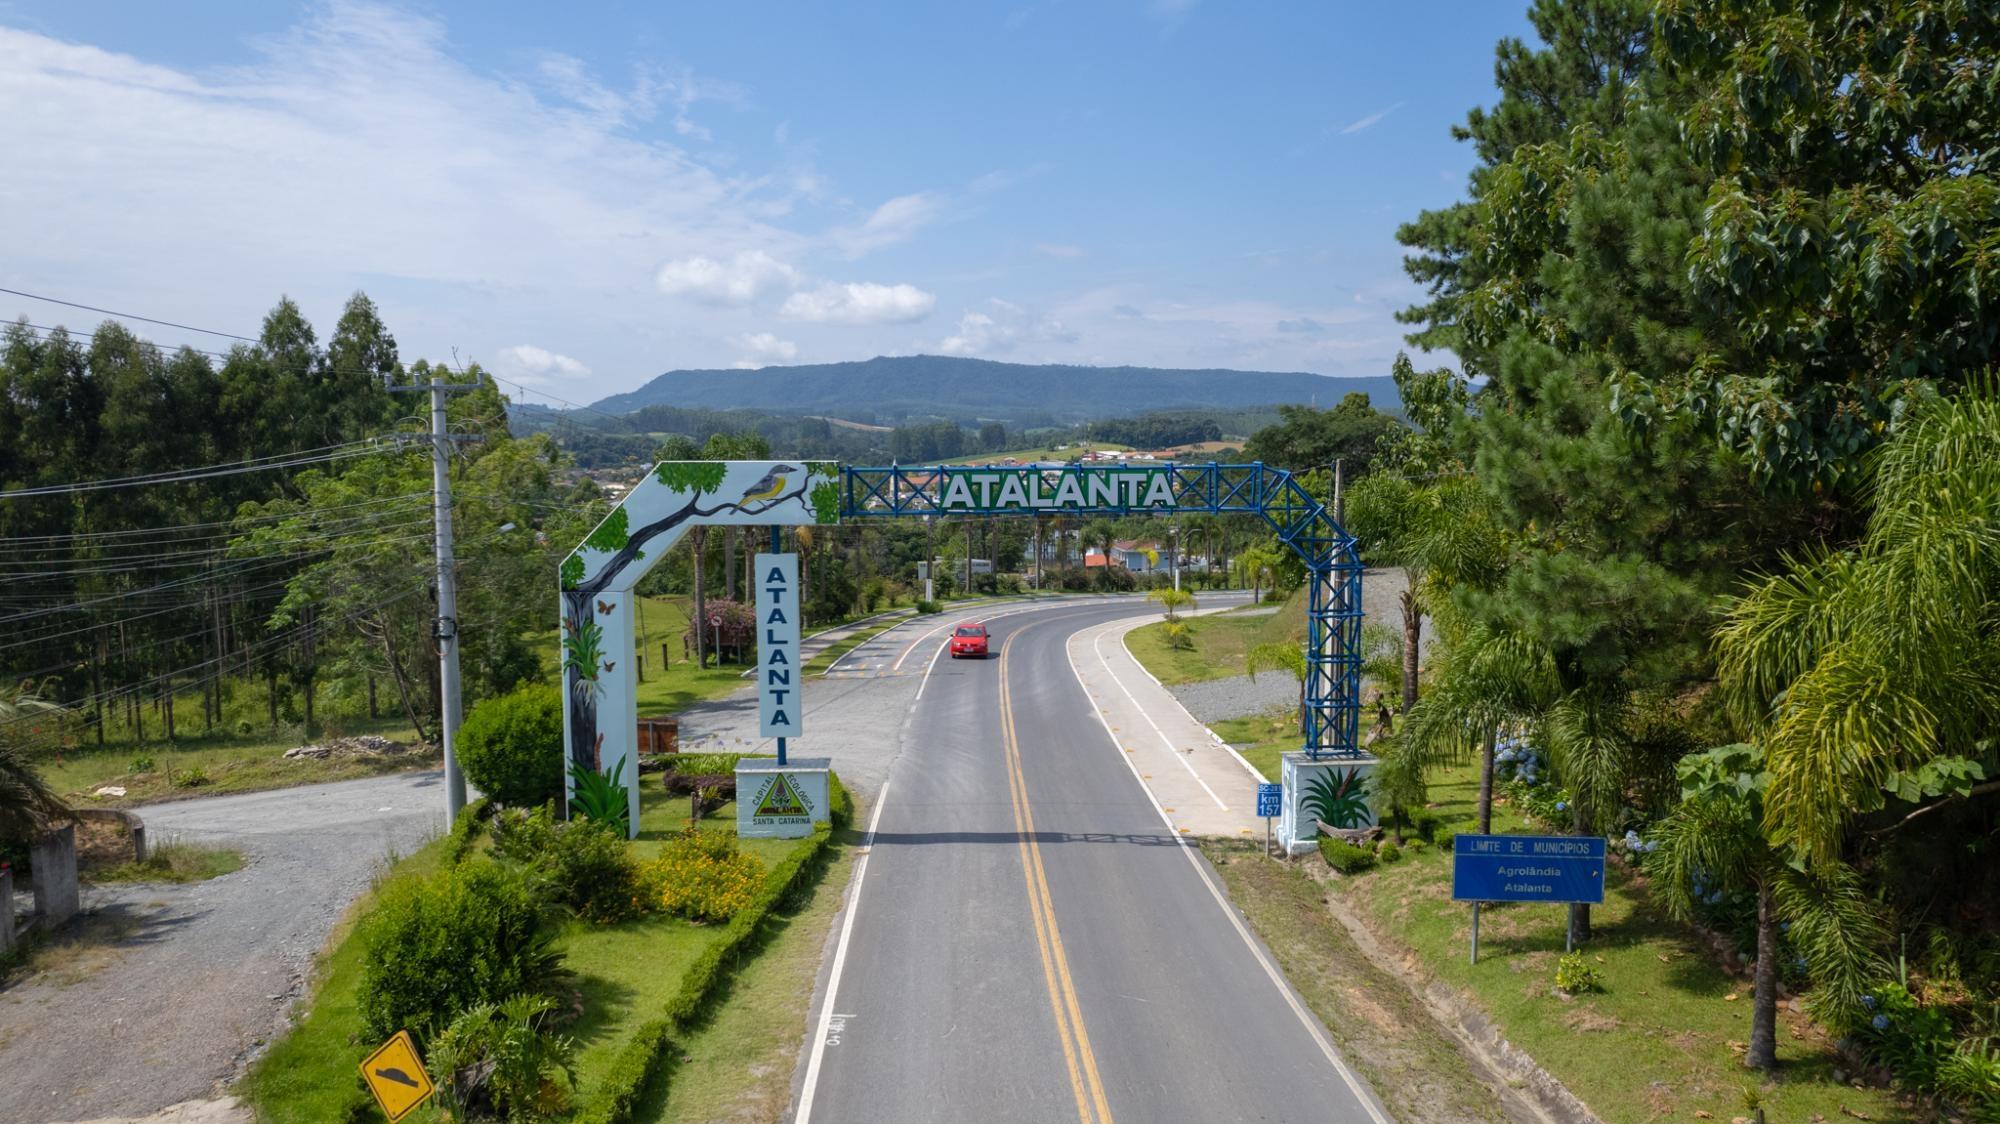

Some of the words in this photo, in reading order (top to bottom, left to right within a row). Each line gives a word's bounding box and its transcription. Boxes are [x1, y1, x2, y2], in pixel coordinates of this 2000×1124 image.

[942, 473, 1177, 508] ATALANTA
[766, 567, 790, 726] ATALANTA
[752, 775, 775, 807] CAPITAL
[786, 773, 815, 812] ECOLÓGICA
[1262, 793, 1279, 804] km
[1260, 804, 1280, 816] 157
[753, 818, 775, 826] SANTA
[778, 817, 811, 825] CATARINA
[1470, 840, 1501, 853] LIMITE
[1510, 841, 1524, 853] DE
[1533, 840, 1590, 855] MUNICÍPIOS
[1498, 866, 1561, 878] Agrolândia
[1504, 882, 1553, 894] Atalanta
